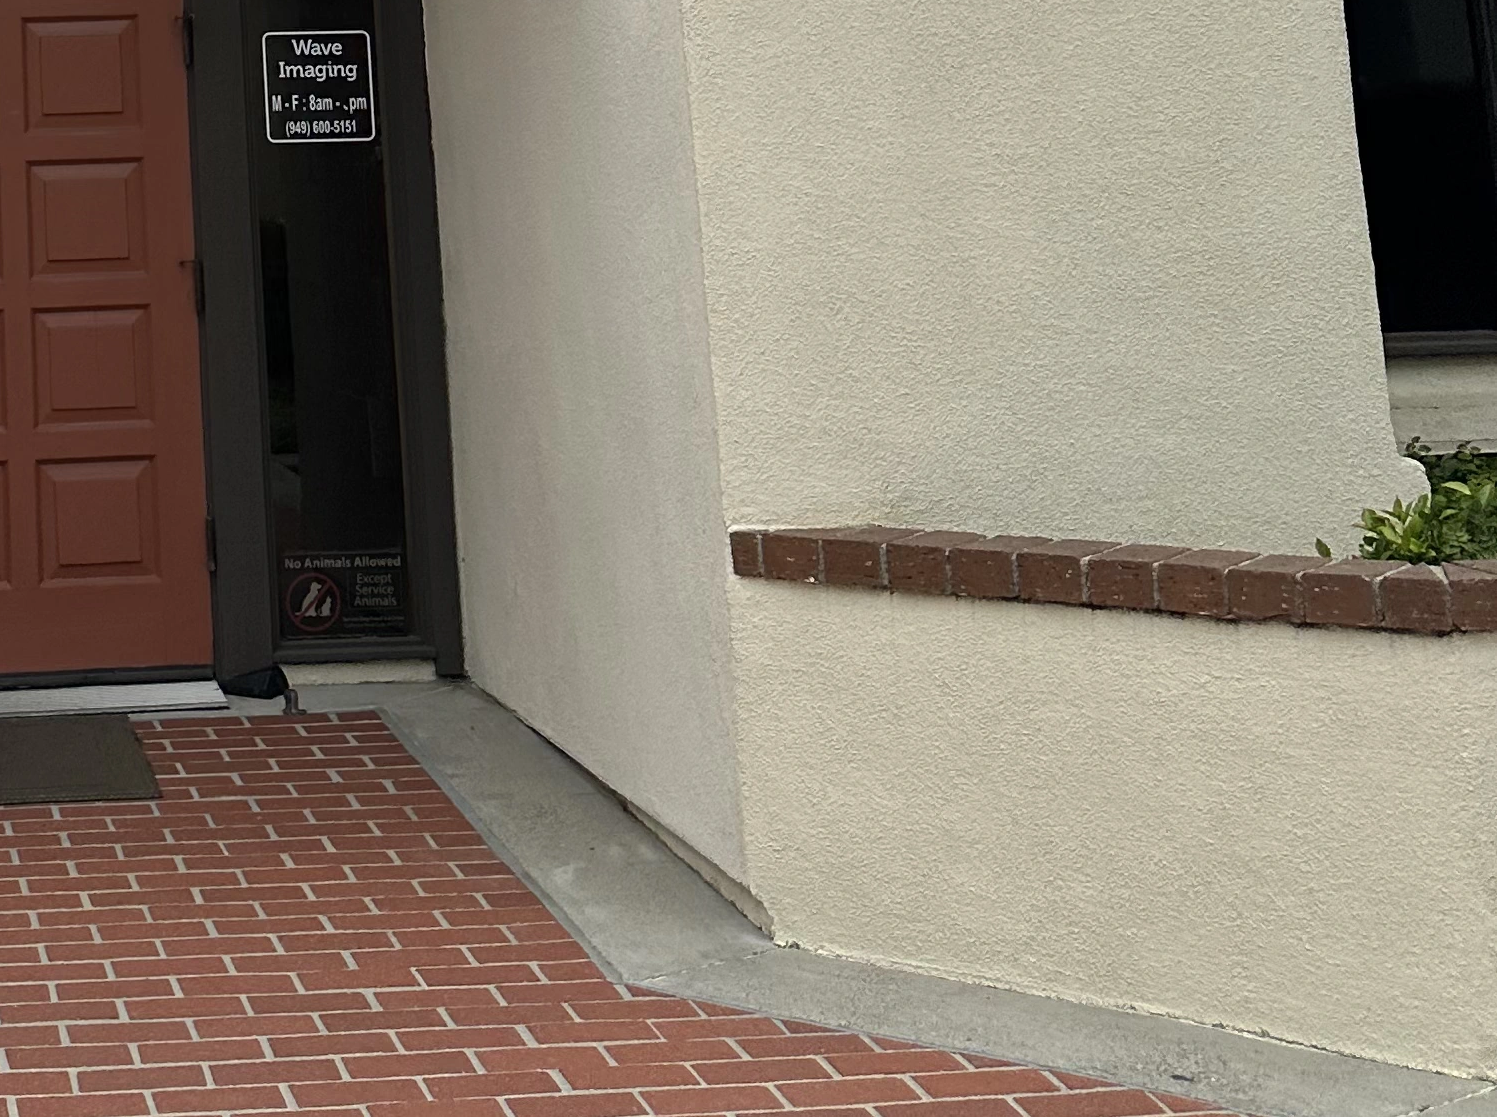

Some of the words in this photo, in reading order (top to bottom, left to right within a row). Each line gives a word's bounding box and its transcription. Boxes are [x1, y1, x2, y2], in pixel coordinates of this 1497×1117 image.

[291, 39, 343, 56] Wave
[278, 61, 357, 81] Imaging
[309, 94, 333, 111] 8am
[285, 120, 311, 137] (949)
[312, 119, 357, 134] 600-5151
[284, 558, 301, 569] No
[304, 556, 351, 568] Animals
[354, 555, 401, 567] Allowed
[356, 573, 392, 584] Except
[355, 584, 394, 595] Service
[354, 595, 397, 606] Animals
